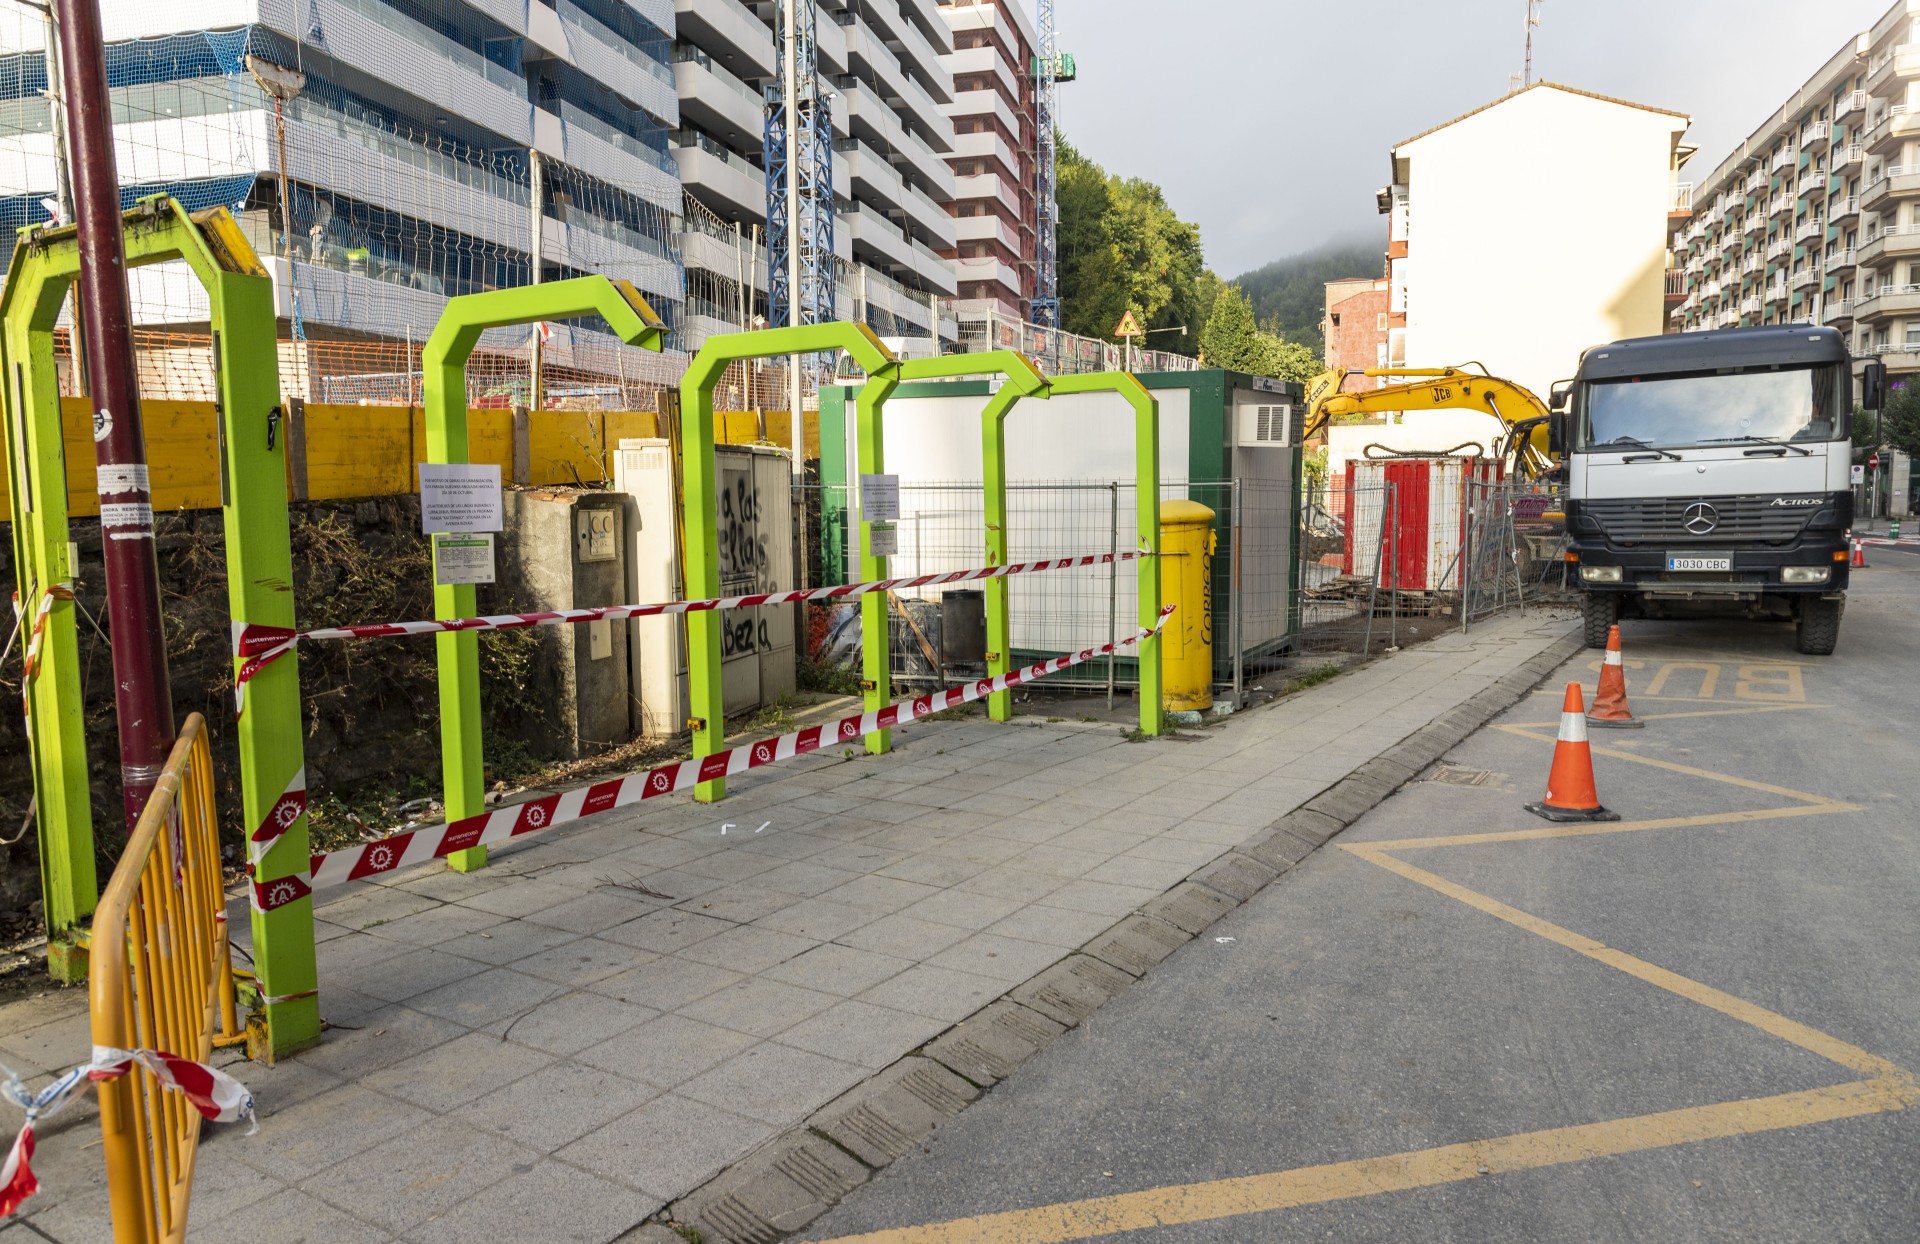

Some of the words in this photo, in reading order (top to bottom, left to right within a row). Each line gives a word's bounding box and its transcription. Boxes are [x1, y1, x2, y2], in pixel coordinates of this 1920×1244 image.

[1433, 387, 1451, 402] JCB
[1676, 559, 1703, 569] 3030
[1706, 559, 1727, 569] CBC
[1201, 540, 1212, 646] CORREOS
